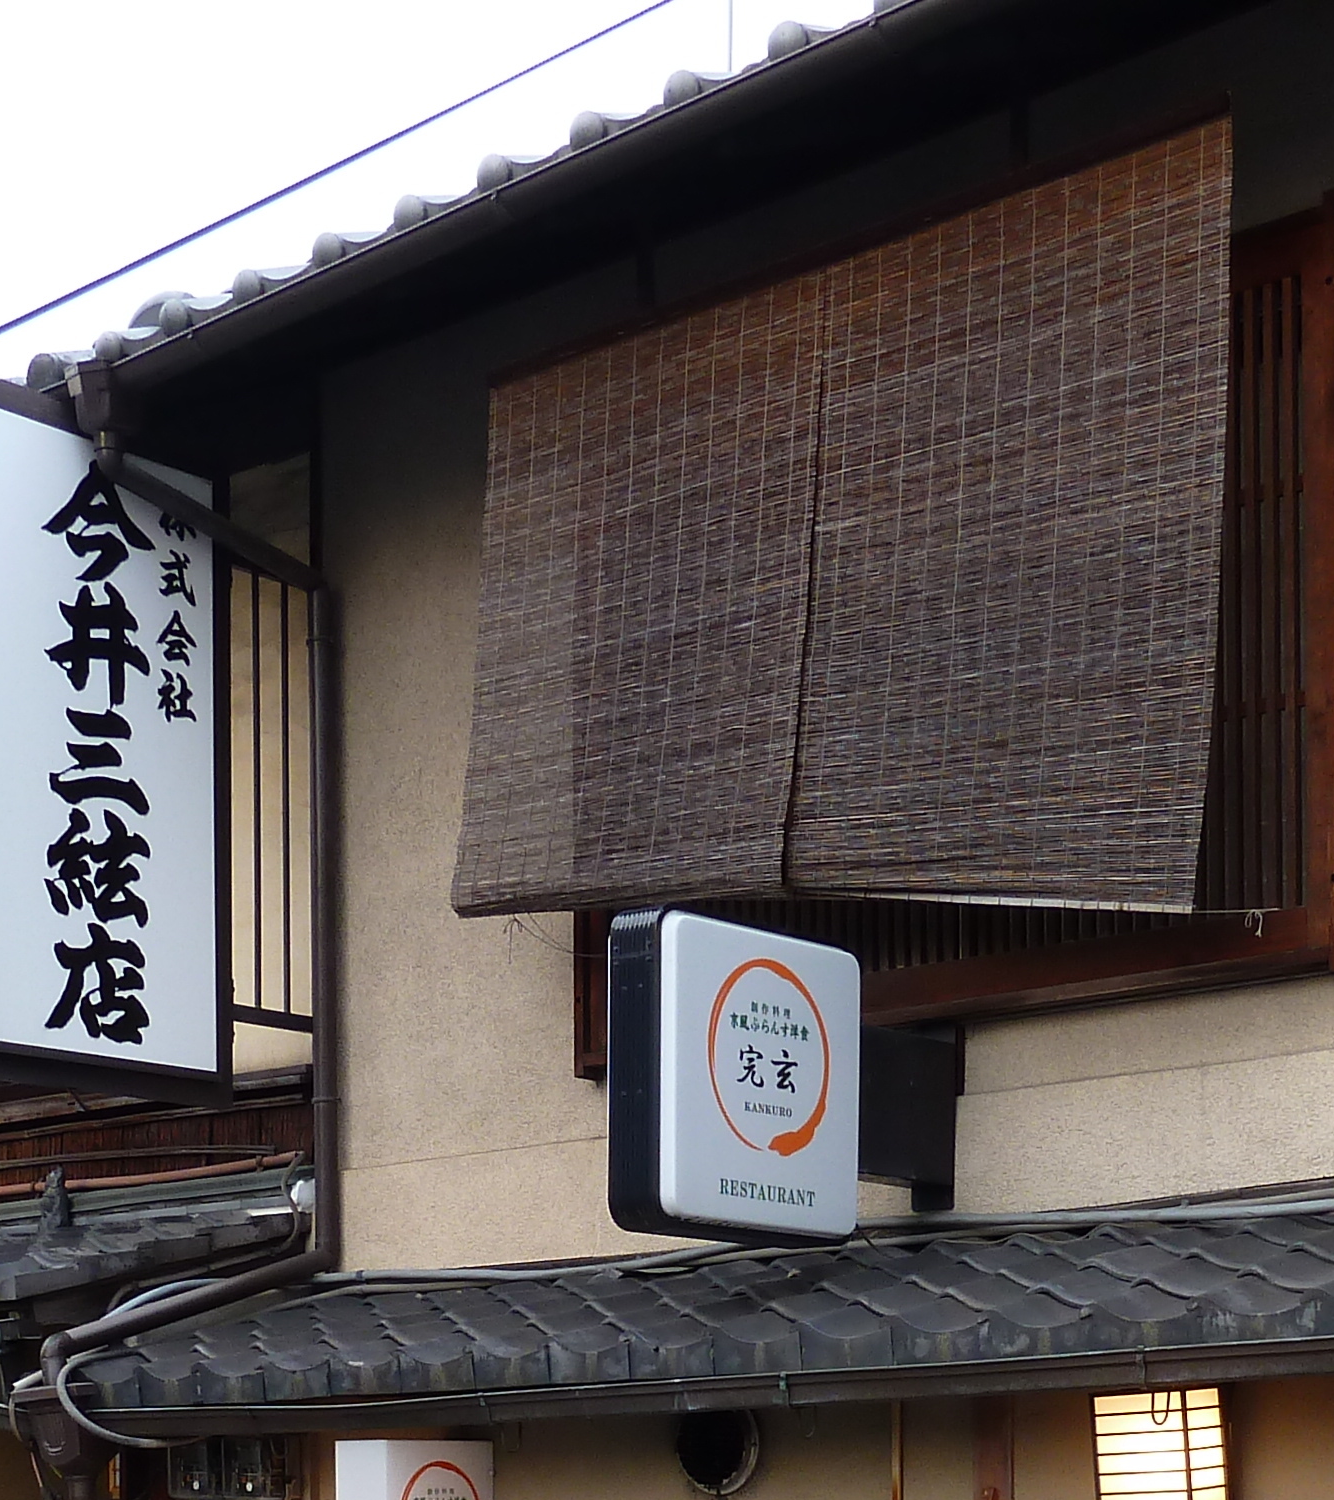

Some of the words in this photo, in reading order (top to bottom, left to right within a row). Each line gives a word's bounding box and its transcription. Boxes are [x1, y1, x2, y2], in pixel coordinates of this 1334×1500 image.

[41, 459, 156, 1046] 今井三絃店
[750, 1000, 792, 1020] 創作料理
[736, 1045, 799, 1094] 完玄
[744, 1101, 793, 1118] KANKURO
[719, 1178, 816, 1208] RESTAURANT
